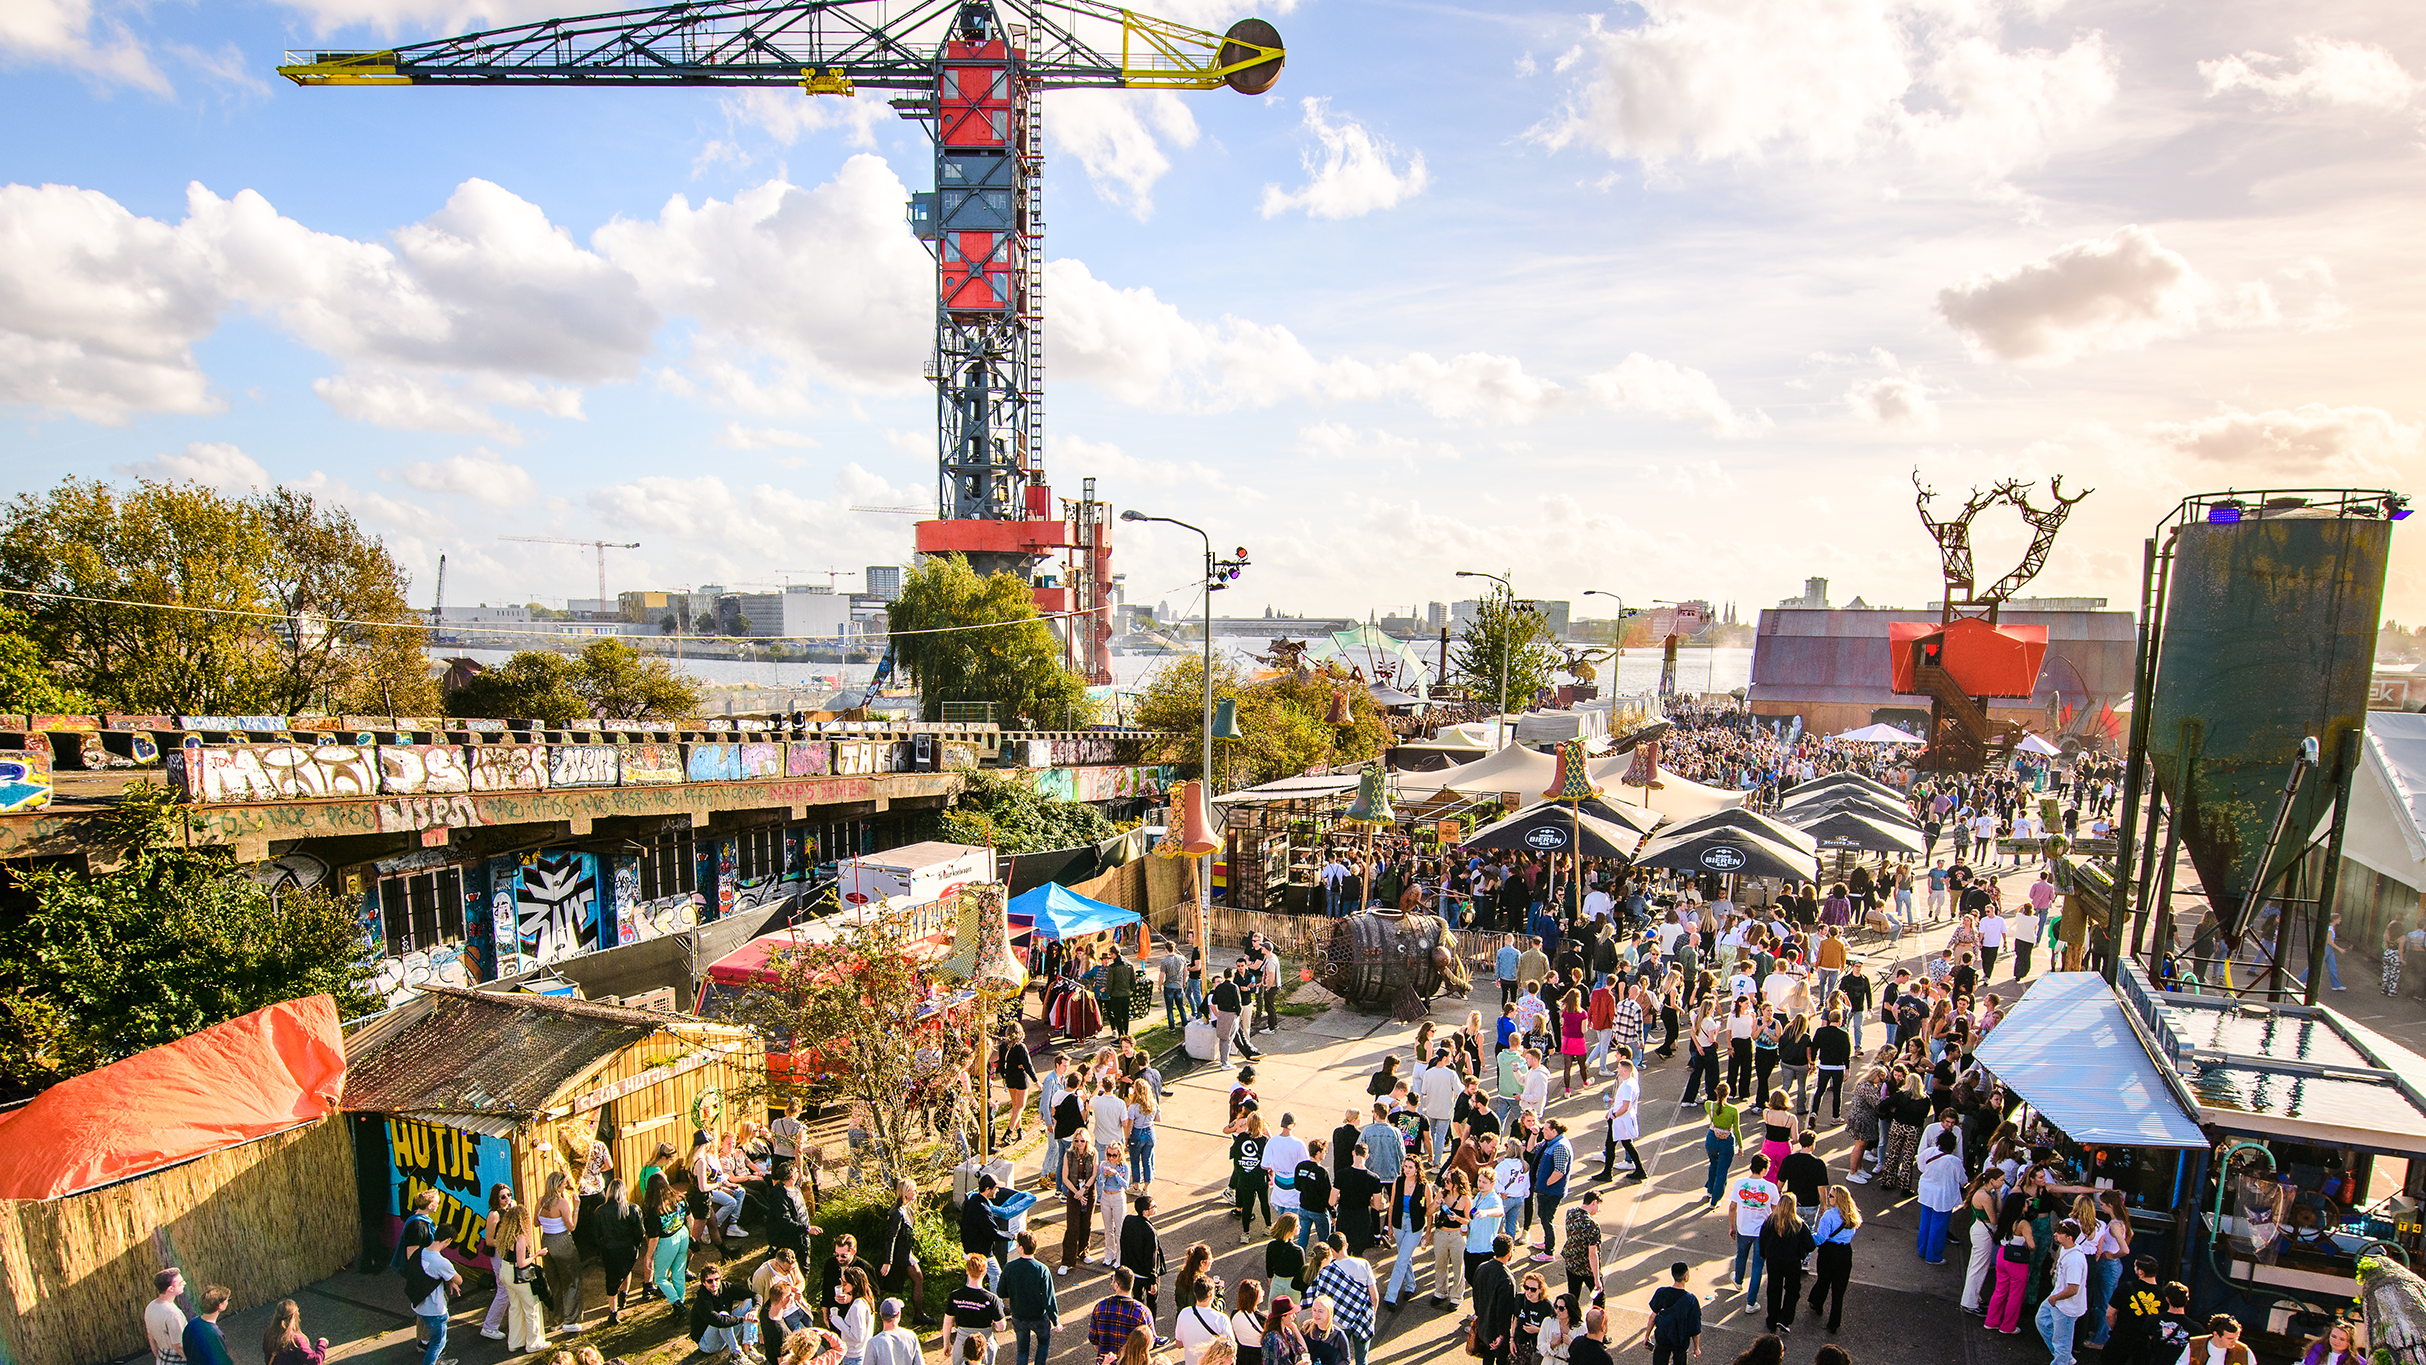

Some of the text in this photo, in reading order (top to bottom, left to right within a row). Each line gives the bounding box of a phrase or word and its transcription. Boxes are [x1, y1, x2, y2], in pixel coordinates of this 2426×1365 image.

[1529, 836, 1563, 844] BIEREN
[1705, 856, 1741, 865] BIEREN
[580, 1083, 619, 1110] CLUB
[624, 1067, 672, 1093] HUTJE
[390, 1118, 475, 1181] HUTJE
